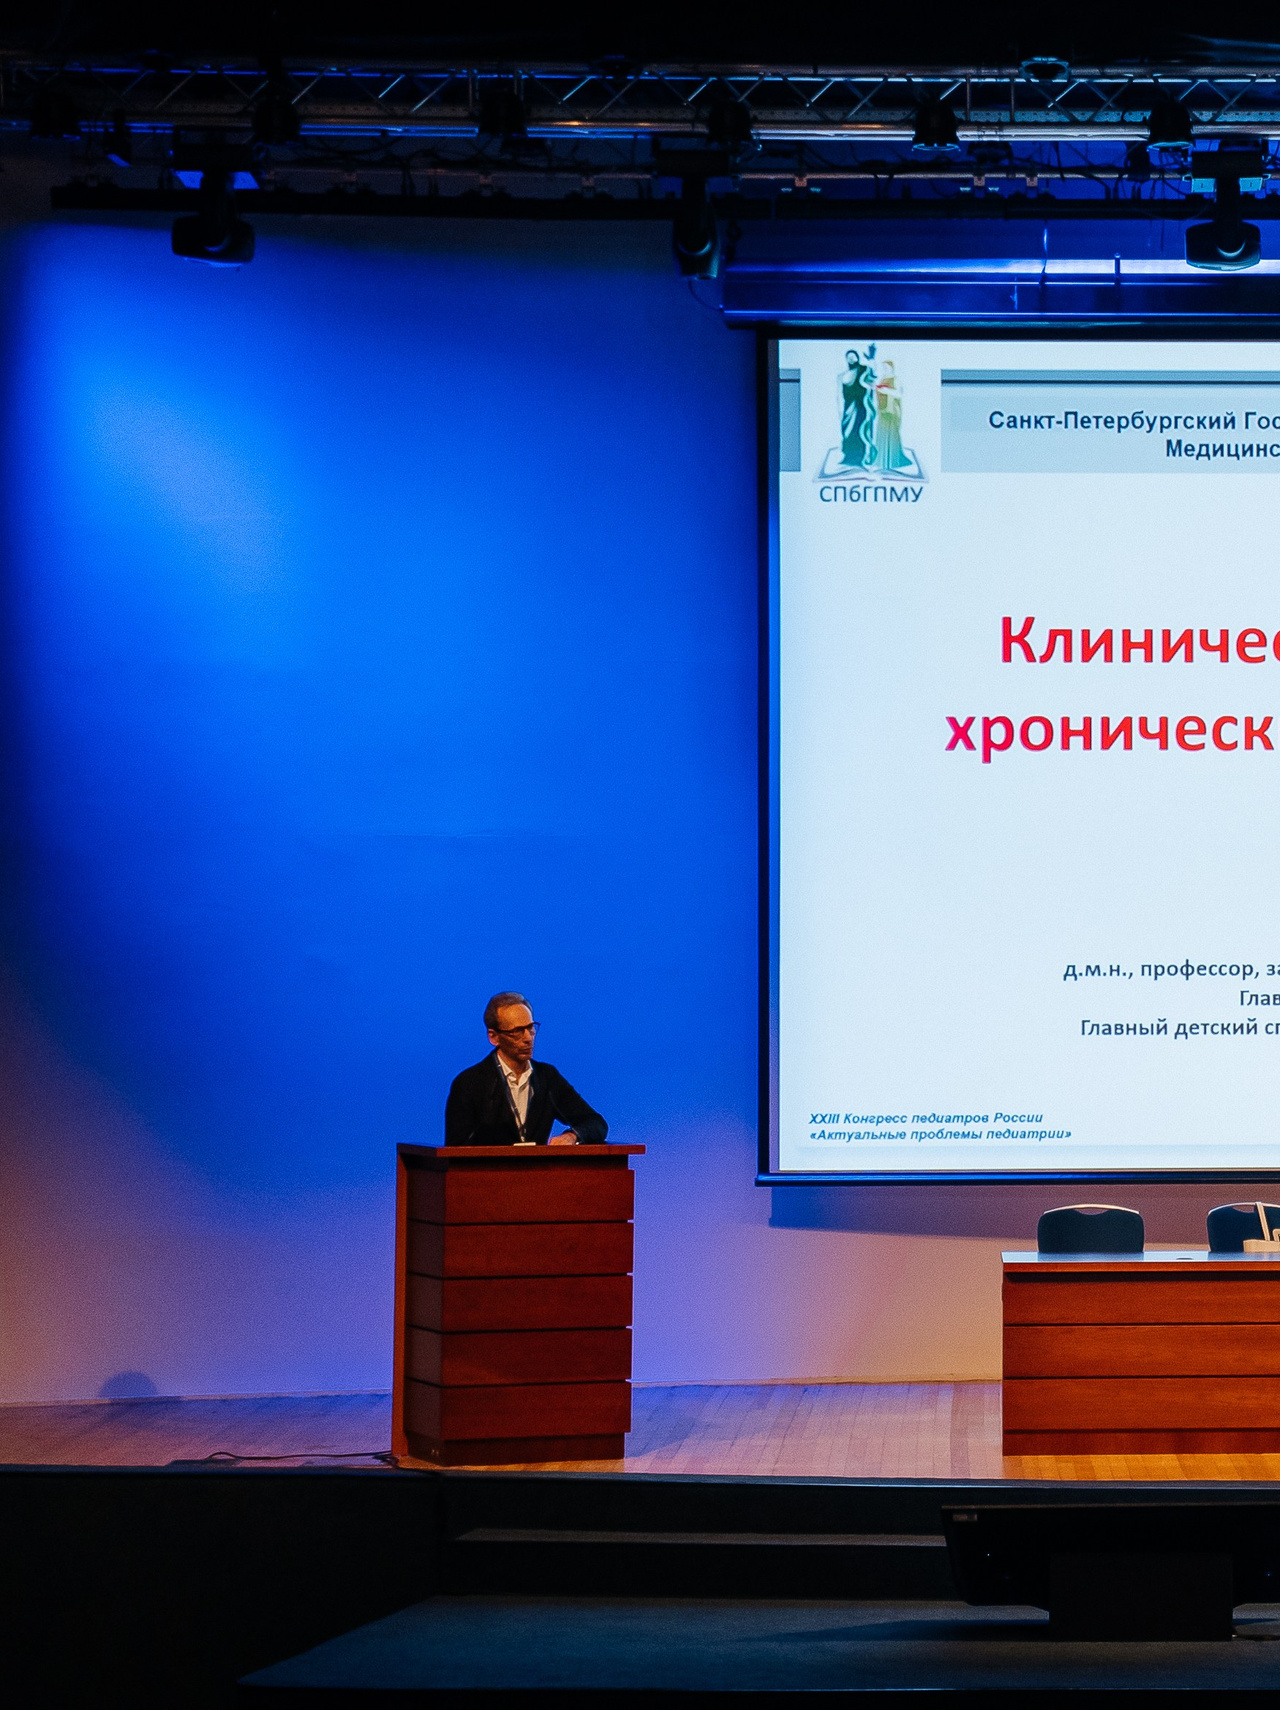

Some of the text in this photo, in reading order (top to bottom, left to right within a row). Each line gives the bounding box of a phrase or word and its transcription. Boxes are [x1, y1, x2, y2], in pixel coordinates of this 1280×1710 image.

[988, 409, 1236, 434] Санкт-Петербургский
[819, 484, 924, 503] СПбГПМУ
[1062, 964, 1134, 982] д.м.н.,
[1140, 958, 1260, 981] профессор,
[1081, 1017, 1168, 1036] Главный
[1173, 1017, 1258, 1041] детский
[808, 1112, 1044, 1127] XXIII Конгресс педиатров России
[809, 1127, 1072, 1143] «Актуальные проблемы педиатрии»
